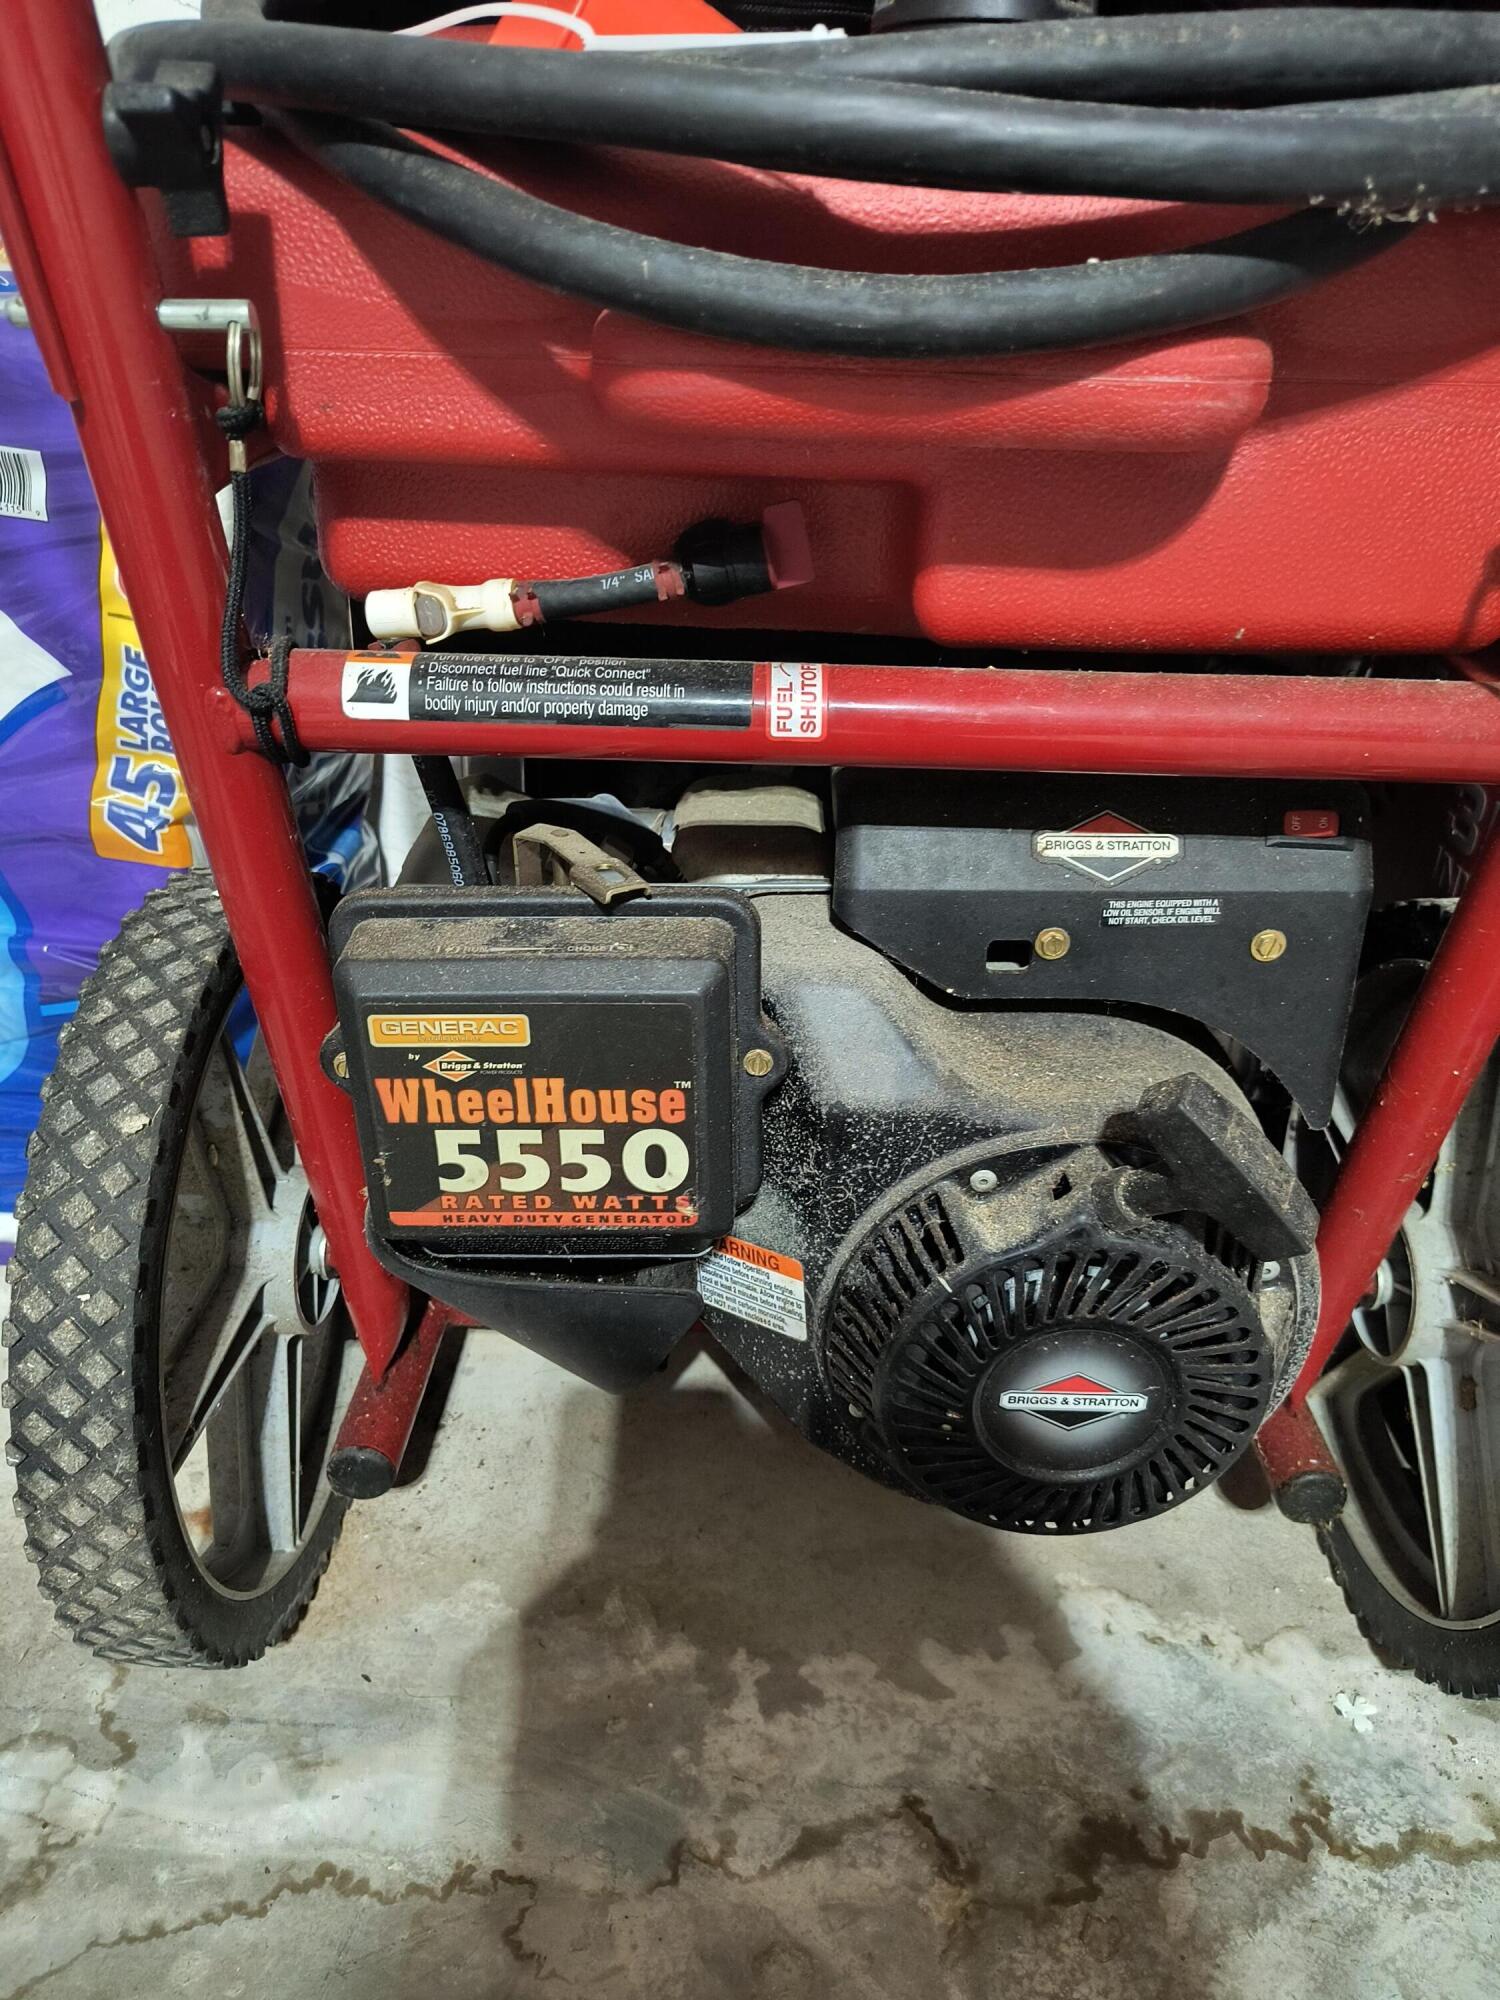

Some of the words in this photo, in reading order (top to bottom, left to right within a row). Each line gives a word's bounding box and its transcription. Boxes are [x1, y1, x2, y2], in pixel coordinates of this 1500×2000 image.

[634, 568, 655, 583] SA
[428, 662, 497, 675] Disconnect
[499, 664, 522, 676] fuel
[525, 665, 548, 677] line
[551, 666, 591, 679] "Quick
[594, 667, 651, 680] Connect"
[426, 676, 469, 692] Failure
[472, 679, 484, 692] to
[487, 679, 524, 694] follow
[526, 680, 597, 696] instructions
[600, 683, 634, 698] could
[636, 684, 671, 699] result
[673, 684, 685, 699] in
[120, 645, 151, 752] LARGE
[776, 681, 793, 733] FUEL
[424, 695, 461, 715] bodily
[464, 696, 500, 716] injury
[501, 698, 541, 714] and/or
[543, 699, 594, 719] property
[597, 701, 649, 721] damage
[103, 755, 177, 853] 45
[1045, 840, 1092, 851] BRIGGS
[1095, 840, 1105, 851] &
[1107, 840, 1171, 852] STRATTON
[1108, 901, 1126, 909] THIS
[1126, 901, 1154, 909] ENGINE
[1155, 900, 1192, 908] EQUIPPED
[1193, 900, 1211, 908] WITH
[1120, 909, 1132, 917] OIL
[1166, 908, 1175, 916] IF
[1175, 908, 1203, 916] ENGINE
[1204, 907, 1221, 915] WILL
[1108, 917, 1123, 925] NOT
[1151, 916, 1177, 924] CHECK
[1177, 916, 1190, 924] OIL
[379, 1020, 518, 1036] GENERAC
[408, 1052, 421, 1062] by
[441, 1062, 472, 1071] Briggs
[483, 1062, 523, 1070] Stratton
[374, 1077, 687, 1125] WheelHouse
[673, 1080, 692, 1089] TM
[434, 1127, 690, 1194] 5550
[440, 1195, 552, 1210] RATED
[571, 1194, 692, 1210] WATTS
[442, 1213, 504, 1225] HEAVY
[513, 1213, 563, 1225] DUTY
[571, 1213, 692, 1225] GENERATOR
[716, 1240, 780, 1271] ARNING
[1007, 1395, 1058, 1405] BRIGGS
[1059, 1395, 1070, 1406] &
[1072, 1396, 1140, 1408] STRATTON
